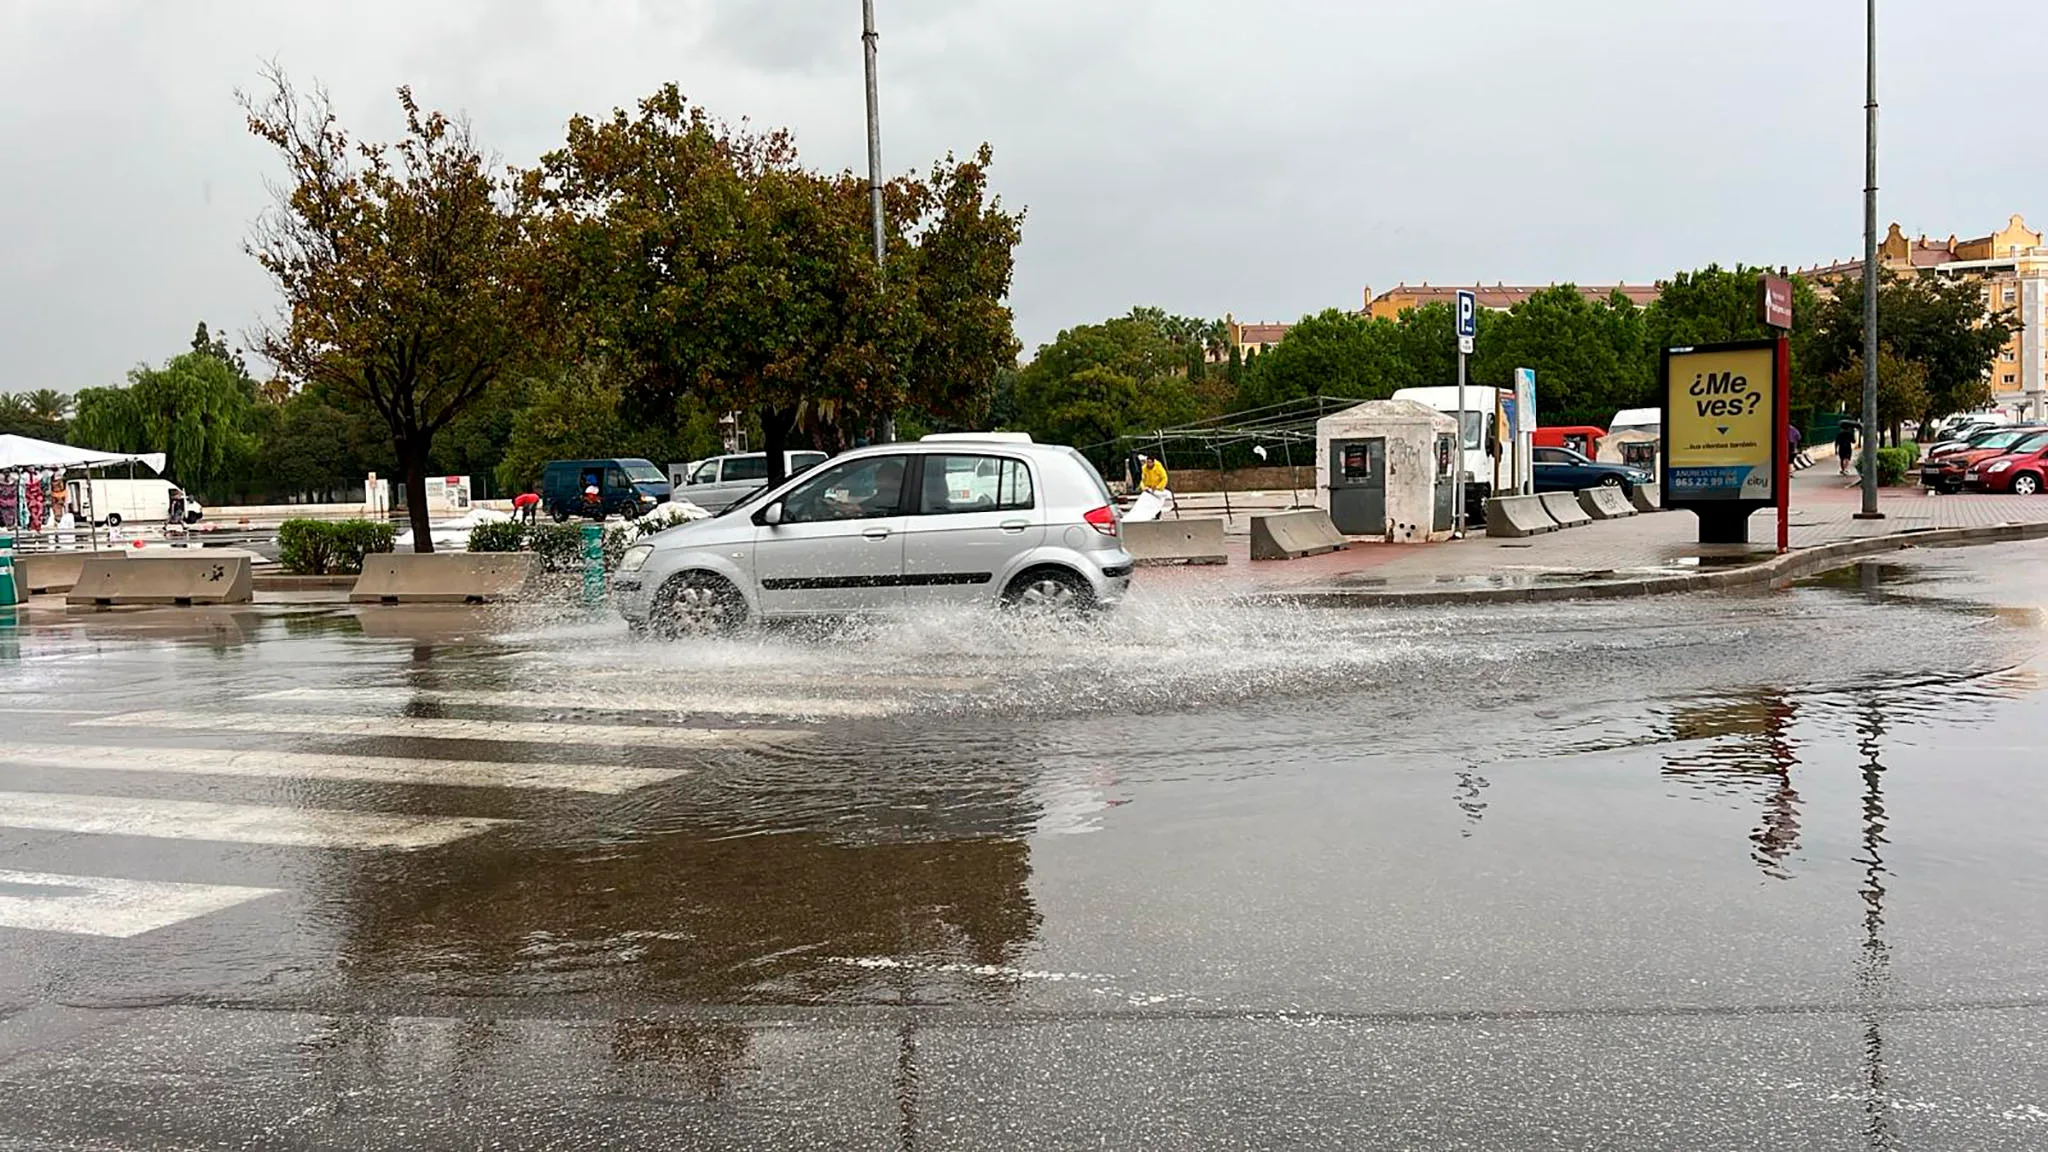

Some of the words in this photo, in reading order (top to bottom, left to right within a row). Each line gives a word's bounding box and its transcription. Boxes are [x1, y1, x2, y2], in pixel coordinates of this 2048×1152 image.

[1461, 296, 1472, 332] P
[1689, 371, 1747, 396] ¿Me
[1696, 391, 1762, 417] ves?
[1695, 478, 1710, 487] 22
[1747, 476, 1768, 488] city
